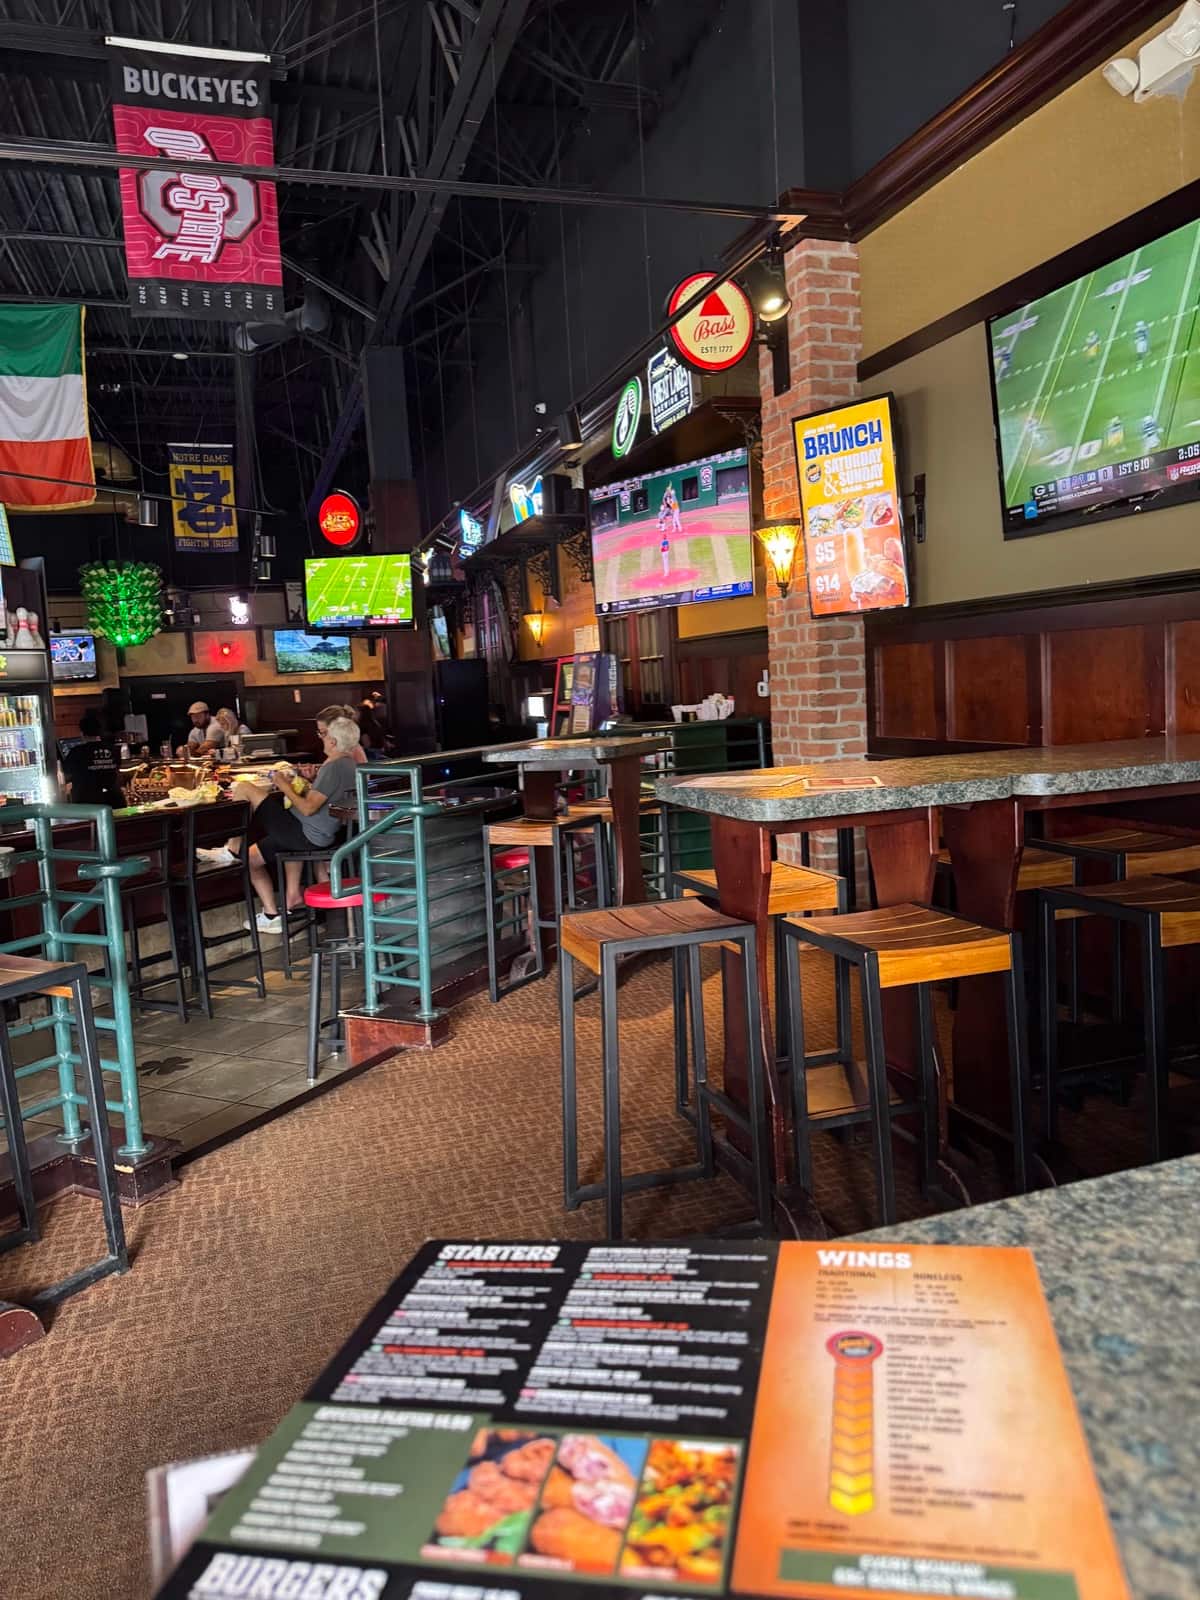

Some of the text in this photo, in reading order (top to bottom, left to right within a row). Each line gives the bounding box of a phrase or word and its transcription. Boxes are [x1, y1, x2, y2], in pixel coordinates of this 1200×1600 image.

[122, 66, 260, 107] BUCKEYES
[152, 188, 230, 264] STATE
[693, 315, 735, 343] Bass
[803, 419, 882, 460] BRUNCH
[172, 452, 229, 464] NOTRE DAME
[823, 447, 882, 474] SATURDAY
[815, 541, 835, 563] $5
[815, 573, 841, 593] $14
[437, 1245, 561, 1262] STARTERS
[816, 1250, 913, 1269] WINGS
[190, 1551, 389, 1600] BURGERS
